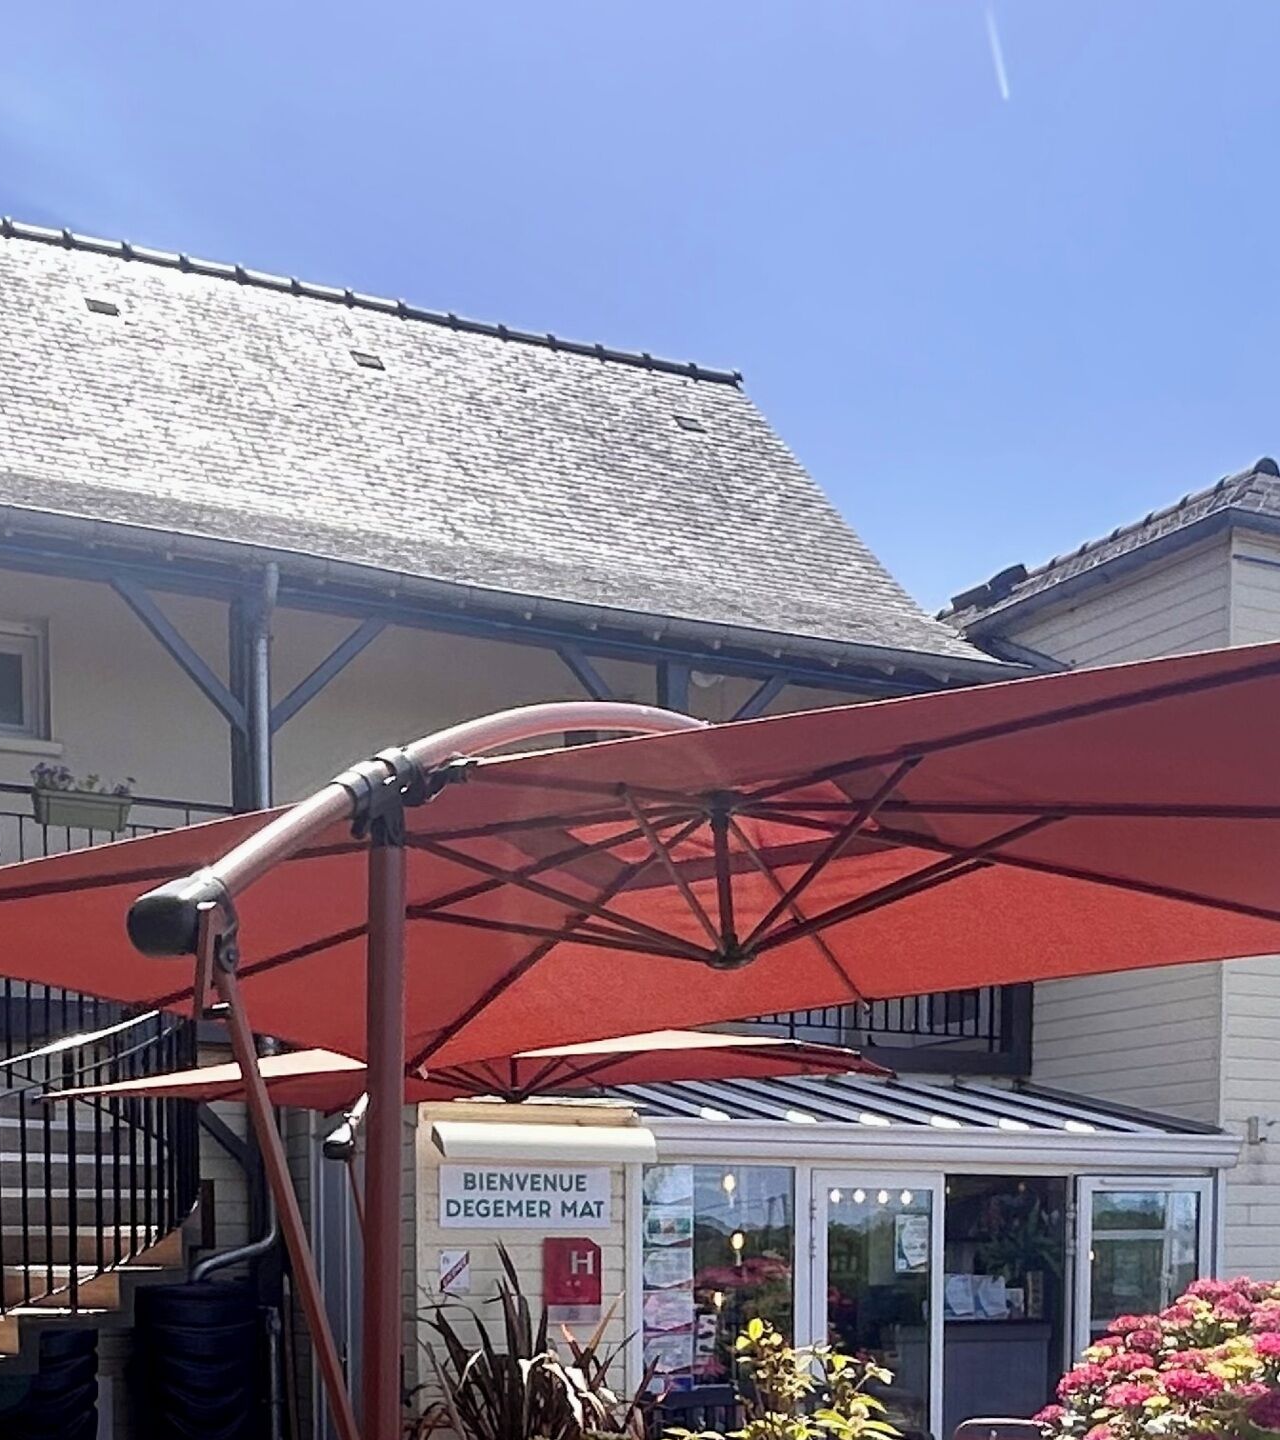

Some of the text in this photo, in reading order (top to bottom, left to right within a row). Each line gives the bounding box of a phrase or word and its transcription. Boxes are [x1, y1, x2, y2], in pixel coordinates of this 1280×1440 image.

[462, 1172, 587, 1192] BIENVENUE
[445, 1199, 605, 1219] DEGEMER MAT
[571, 1250, 595, 1275] H
